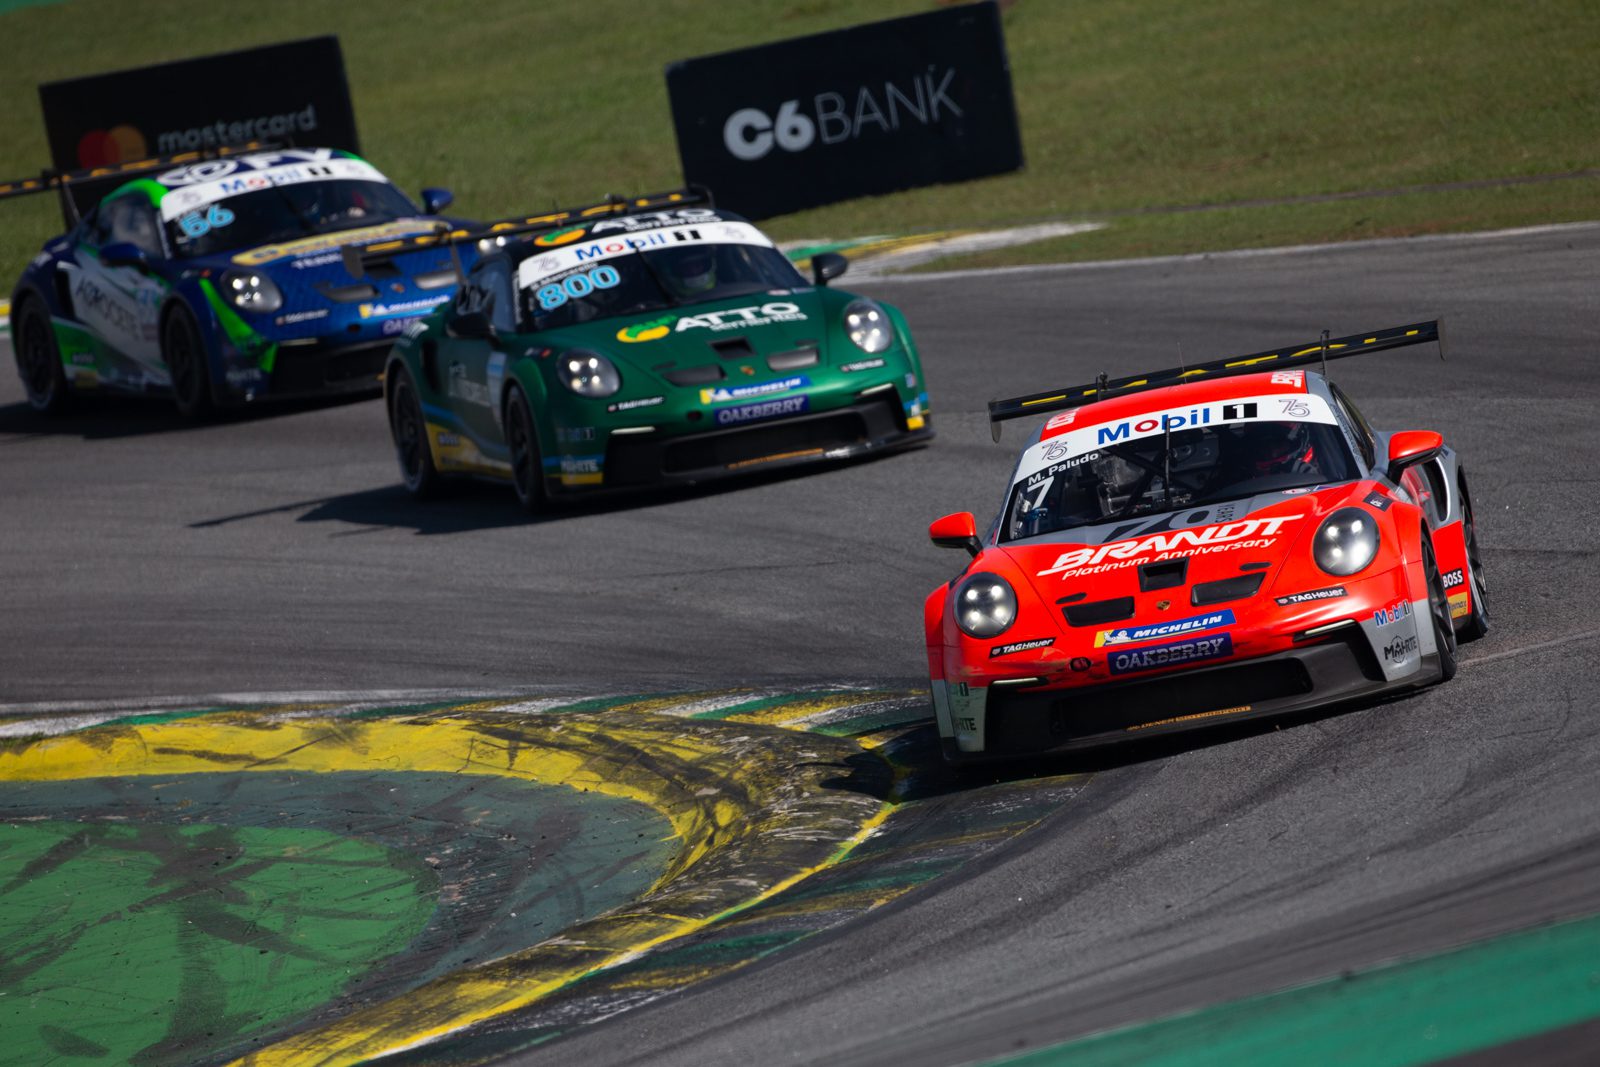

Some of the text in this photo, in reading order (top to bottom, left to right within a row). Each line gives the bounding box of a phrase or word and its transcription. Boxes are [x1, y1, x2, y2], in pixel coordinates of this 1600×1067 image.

[574, 233, 666, 270] Mobil
[536, 264, 621, 311] 800
[674, 302, 800, 333] ATTO
[718, 396, 805, 425] OAKBERRY
[1041, 441, 1068, 461] 75
[1098, 408, 1210, 446] Mobil
[1278, 398, 1310, 418] 75
[1027, 452, 1100, 486] M. Paludo
[1026, 475, 1055, 508] 7
[1036, 513, 1304, 577] BRANDT
[1061, 537, 1277, 581] Platinum Anniversary
[1442, 569, 1464, 588] BOSS
[1132, 613, 1224, 639] MICHELIN
[1375, 604, 1404, 626] Mobil
[1115, 637, 1225, 671] OAKBERRY
